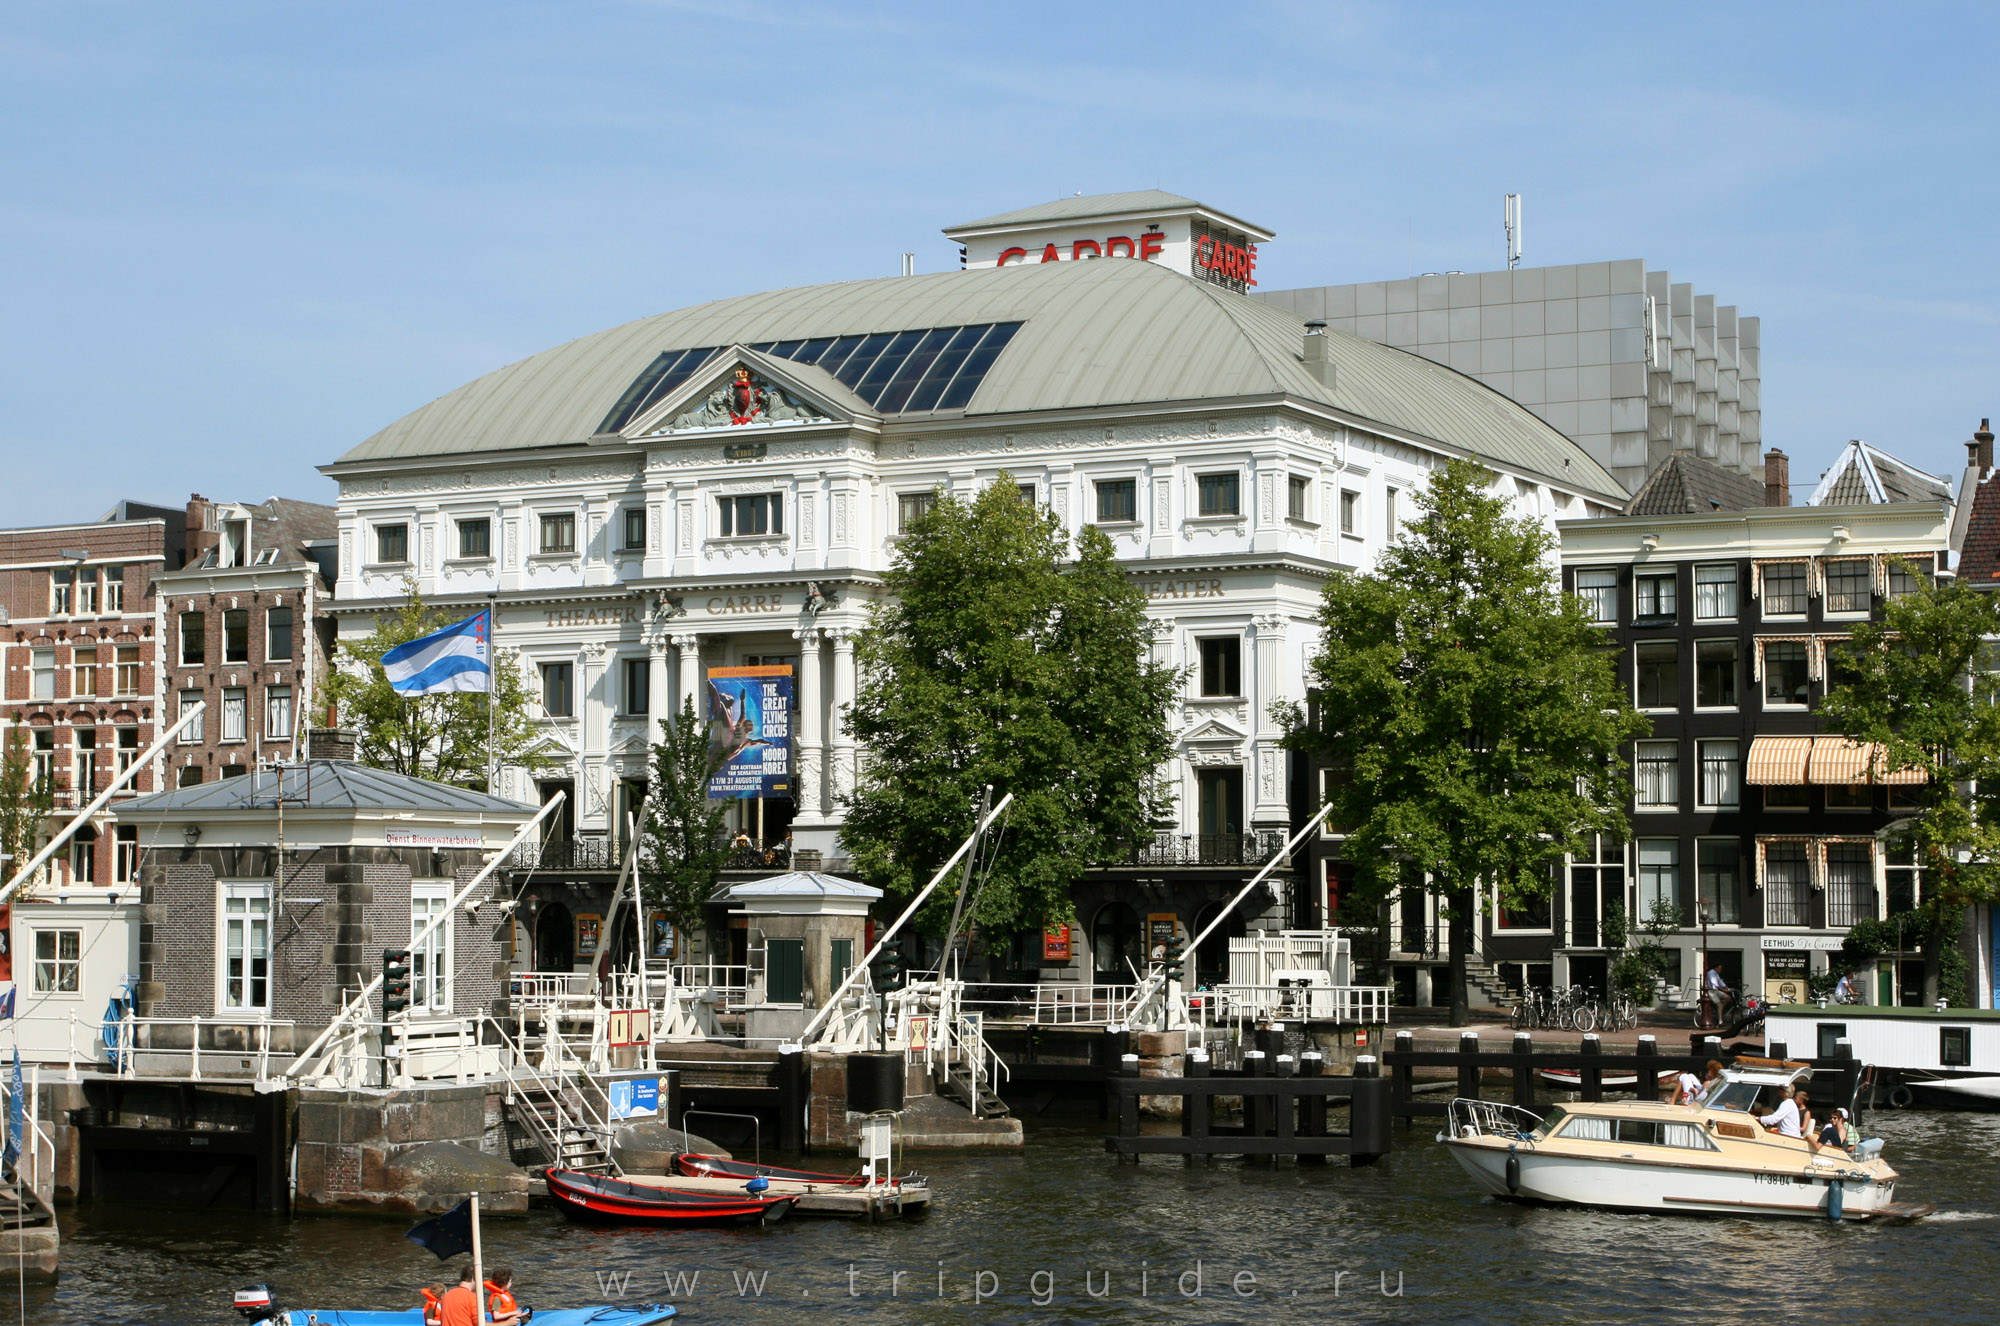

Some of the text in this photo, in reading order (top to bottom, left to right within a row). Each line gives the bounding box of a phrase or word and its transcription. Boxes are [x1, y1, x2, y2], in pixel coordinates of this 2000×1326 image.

[1197, 234, 1258, 287] CARRÉ
[706, 594, 783, 615] CARRE
[544, 606, 640, 627] THEATER
[762, 683, 778, 697] THE
[762, 696, 788, 711] GREAT
[762, 710, 788, 724] FLYING
[762, 724, 788, 738] CIRCUS
[762, 748, 788, 761] NOORD
[762, 761, 787, 775] KOREA
[735, 776, 763, 784] AUGUSTUS
[386, 834, 480, 845] Dienst Binnenwaterbeheer
[1763, 939, 1795, 948] EETHUIS
[963, 1037, 976, 1045] sprt
[1753, 1173, 1790, 1186] YT-38-04
